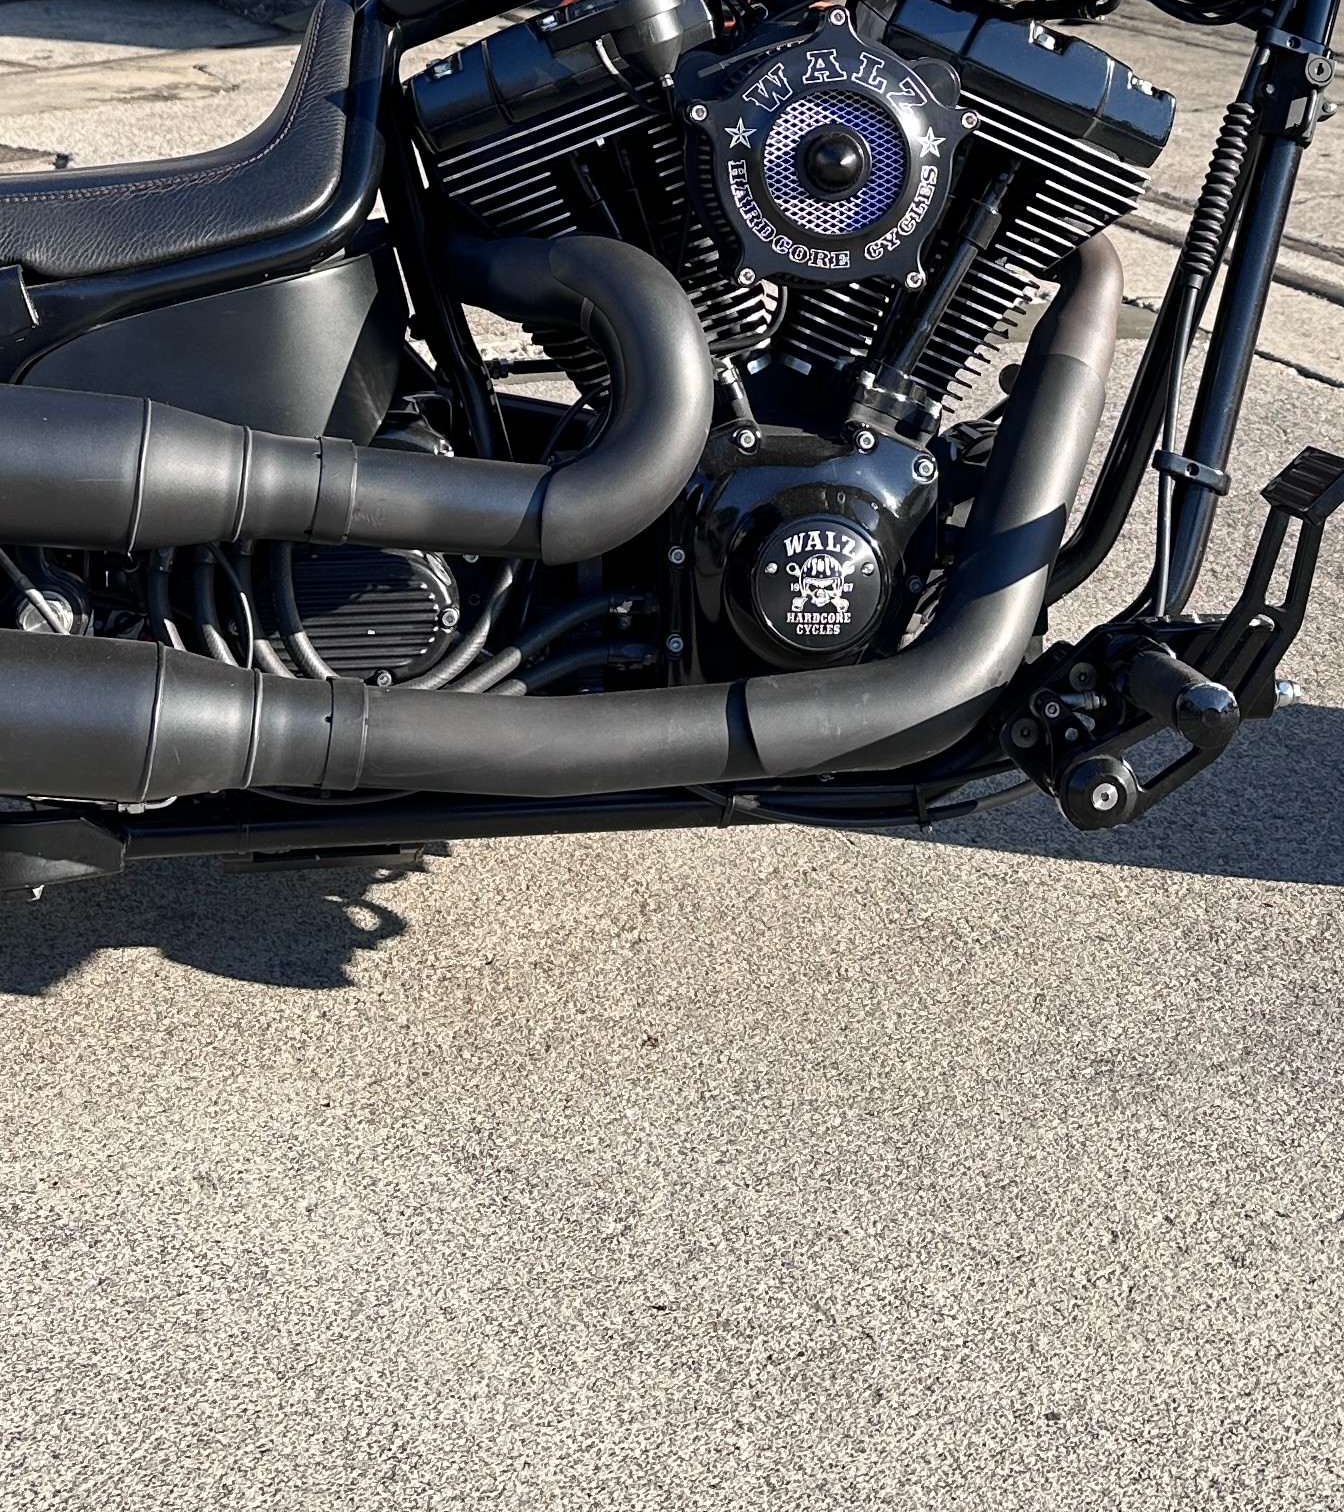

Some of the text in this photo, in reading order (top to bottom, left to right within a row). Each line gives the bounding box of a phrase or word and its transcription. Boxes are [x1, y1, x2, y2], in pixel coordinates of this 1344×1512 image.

[741, 49, 928, 114] WALZ
[727, 160, 939, 269] HARDCORE CYCLES
[784, 531, 857, 558] WALZ
[786, 612, 852, 624] HARDCORE
[796, 624, 841, 635] CYCLES
